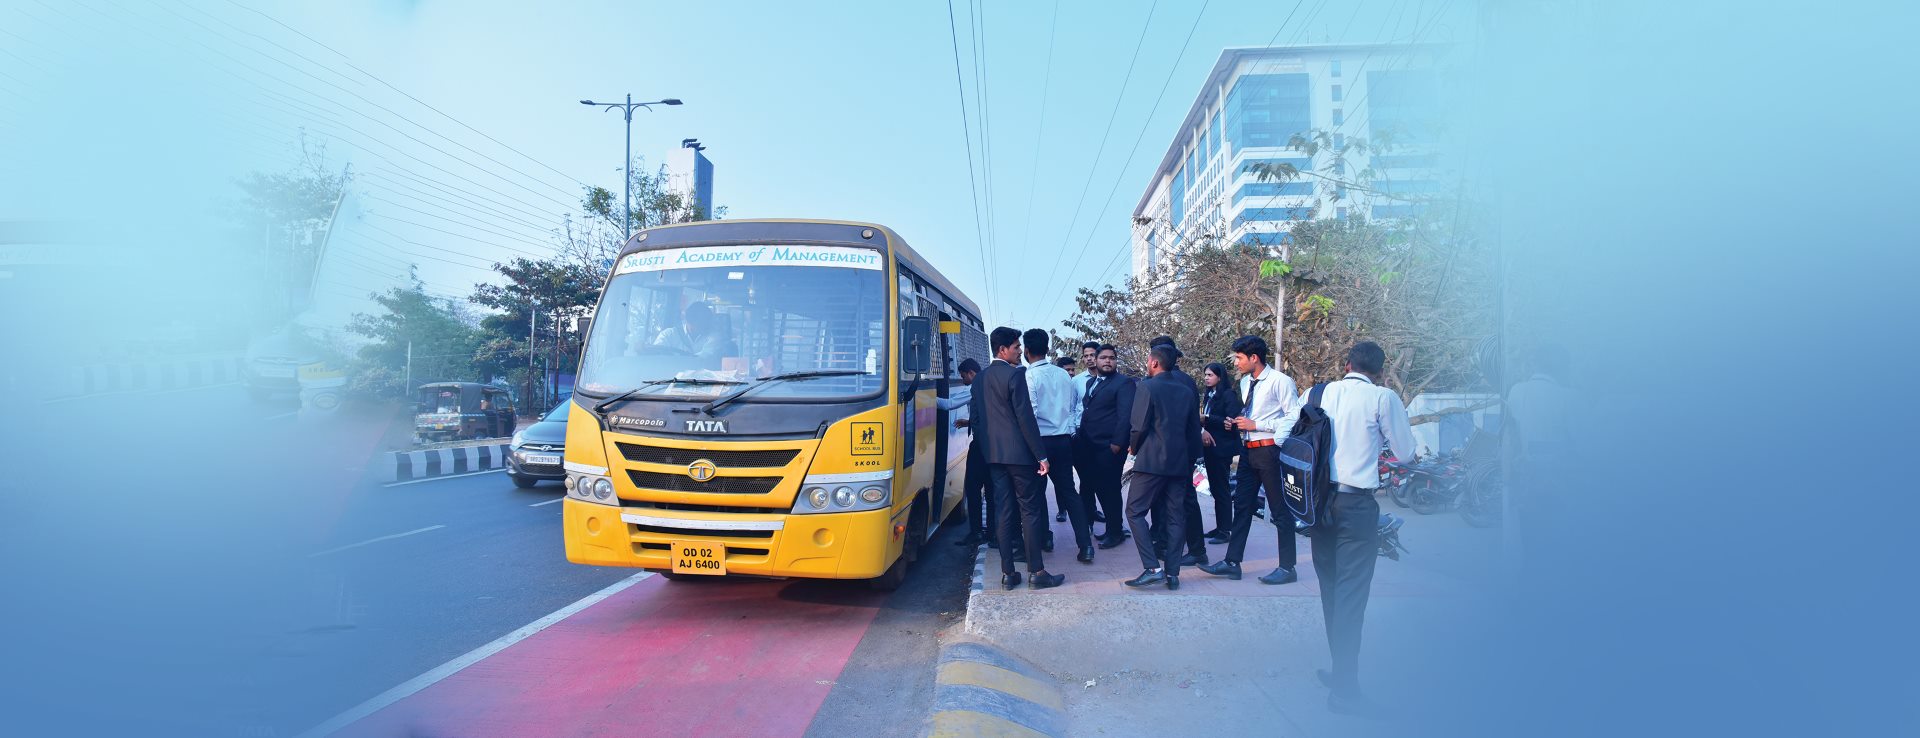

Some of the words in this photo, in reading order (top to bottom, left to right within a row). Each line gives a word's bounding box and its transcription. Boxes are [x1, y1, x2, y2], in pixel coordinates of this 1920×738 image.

[675, 250, 743, 264] ACADEMY
[748, 247, 766, 263] of
[771, 247, 878, 265] MANAGEMENT
[619, 416, 664, 427] Marcopolo
[686, 420, 727, 433] TATA
[683, 548, 698, 557] OD
[700, 548, 713, 558] 02
[679, 559, 692, 568] AJ
[695, 559, 720, 570] 6400
